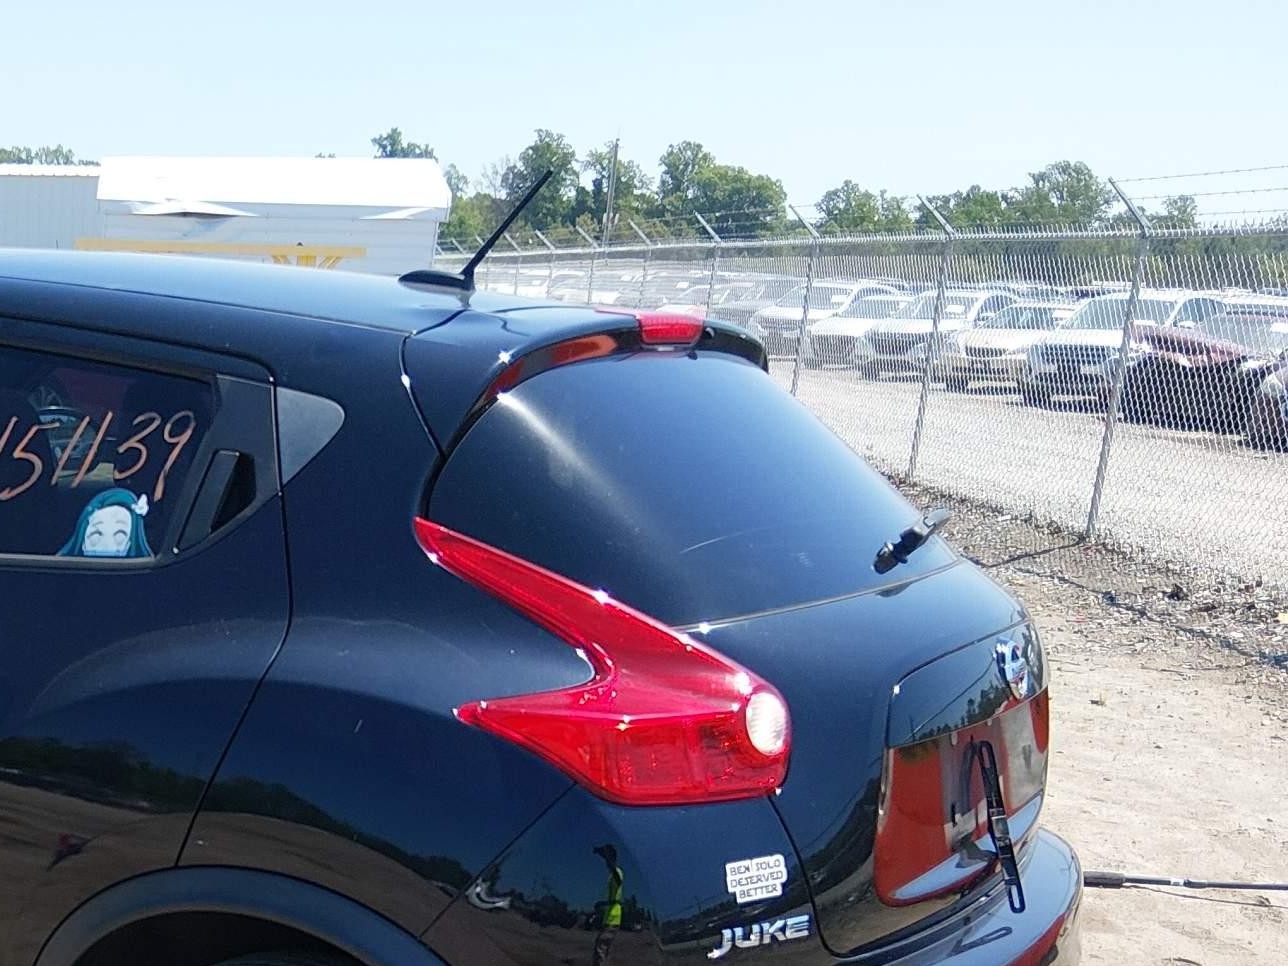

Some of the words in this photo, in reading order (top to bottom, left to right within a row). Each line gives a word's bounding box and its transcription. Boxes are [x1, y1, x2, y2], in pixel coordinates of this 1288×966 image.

[729, 865, 751, 876] BEN
[755, 859, 781, 872] SOLO
[730, 870, 784, 888] DESERVED
[738, 883, 778, 899] BETTER
[706, 914, 810, 959] JUKE
